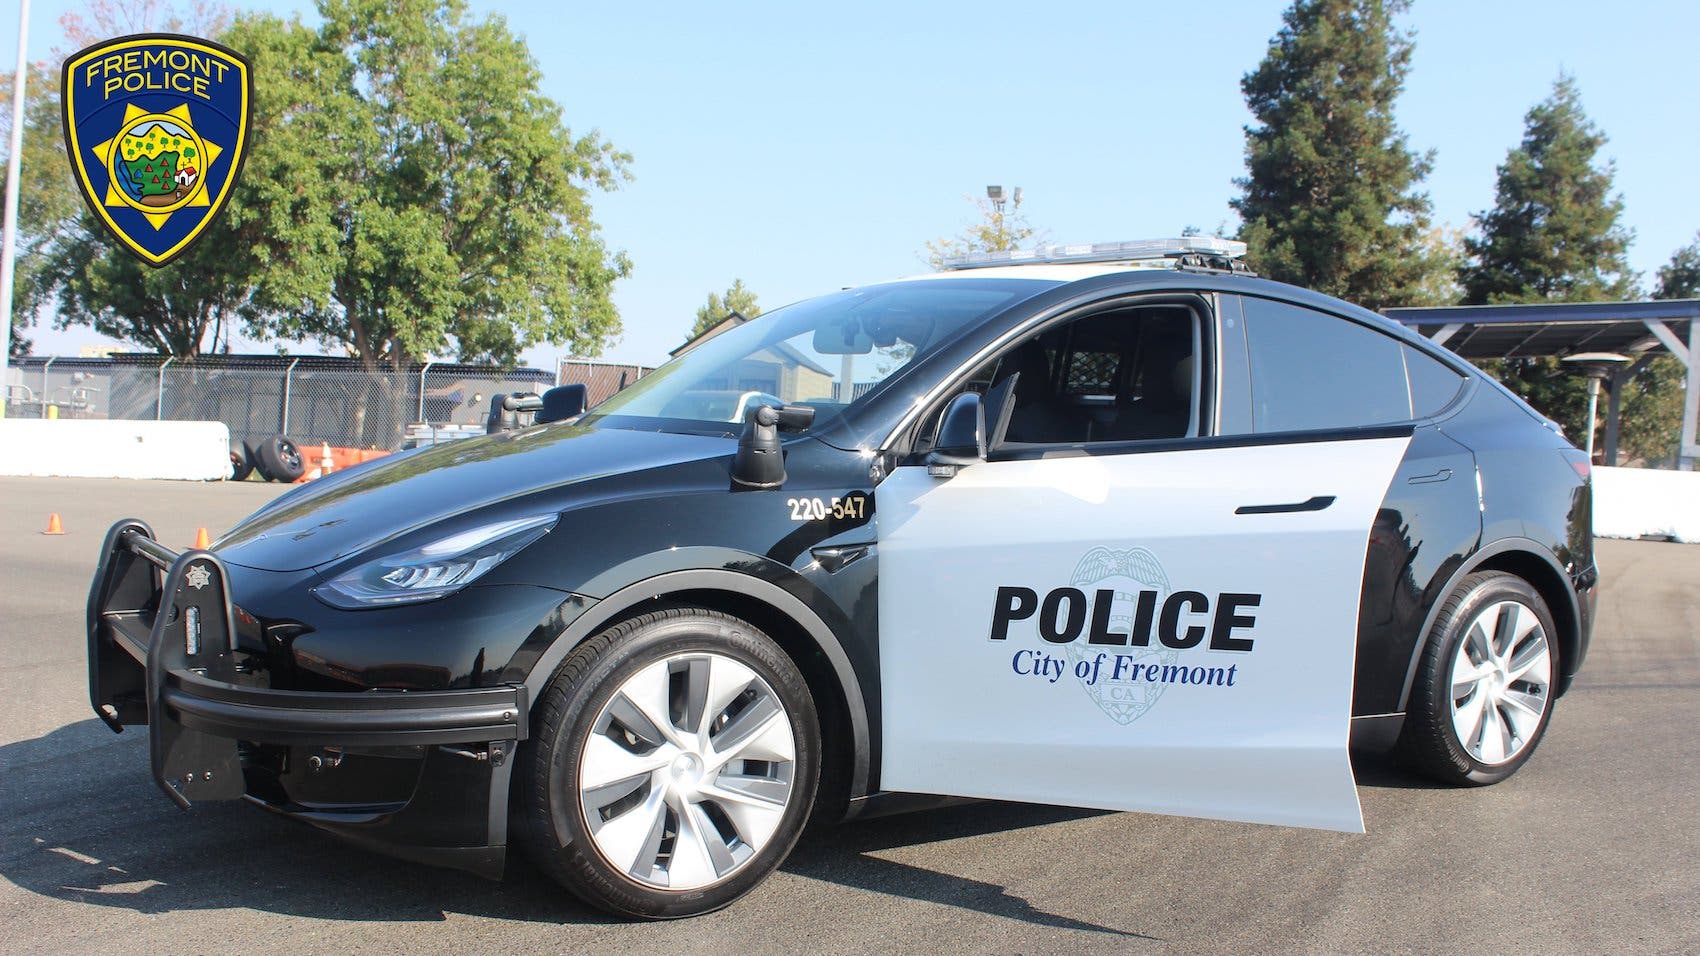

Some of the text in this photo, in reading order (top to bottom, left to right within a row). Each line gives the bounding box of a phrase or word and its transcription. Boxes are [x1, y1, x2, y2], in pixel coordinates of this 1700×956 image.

[787, 497, 865, 521] 220-547
[989, 586, 1262, 652] POLICE
[1012, 649, 1238, 687] City of Fremont
[1110, 686, 1136, 701] CA
